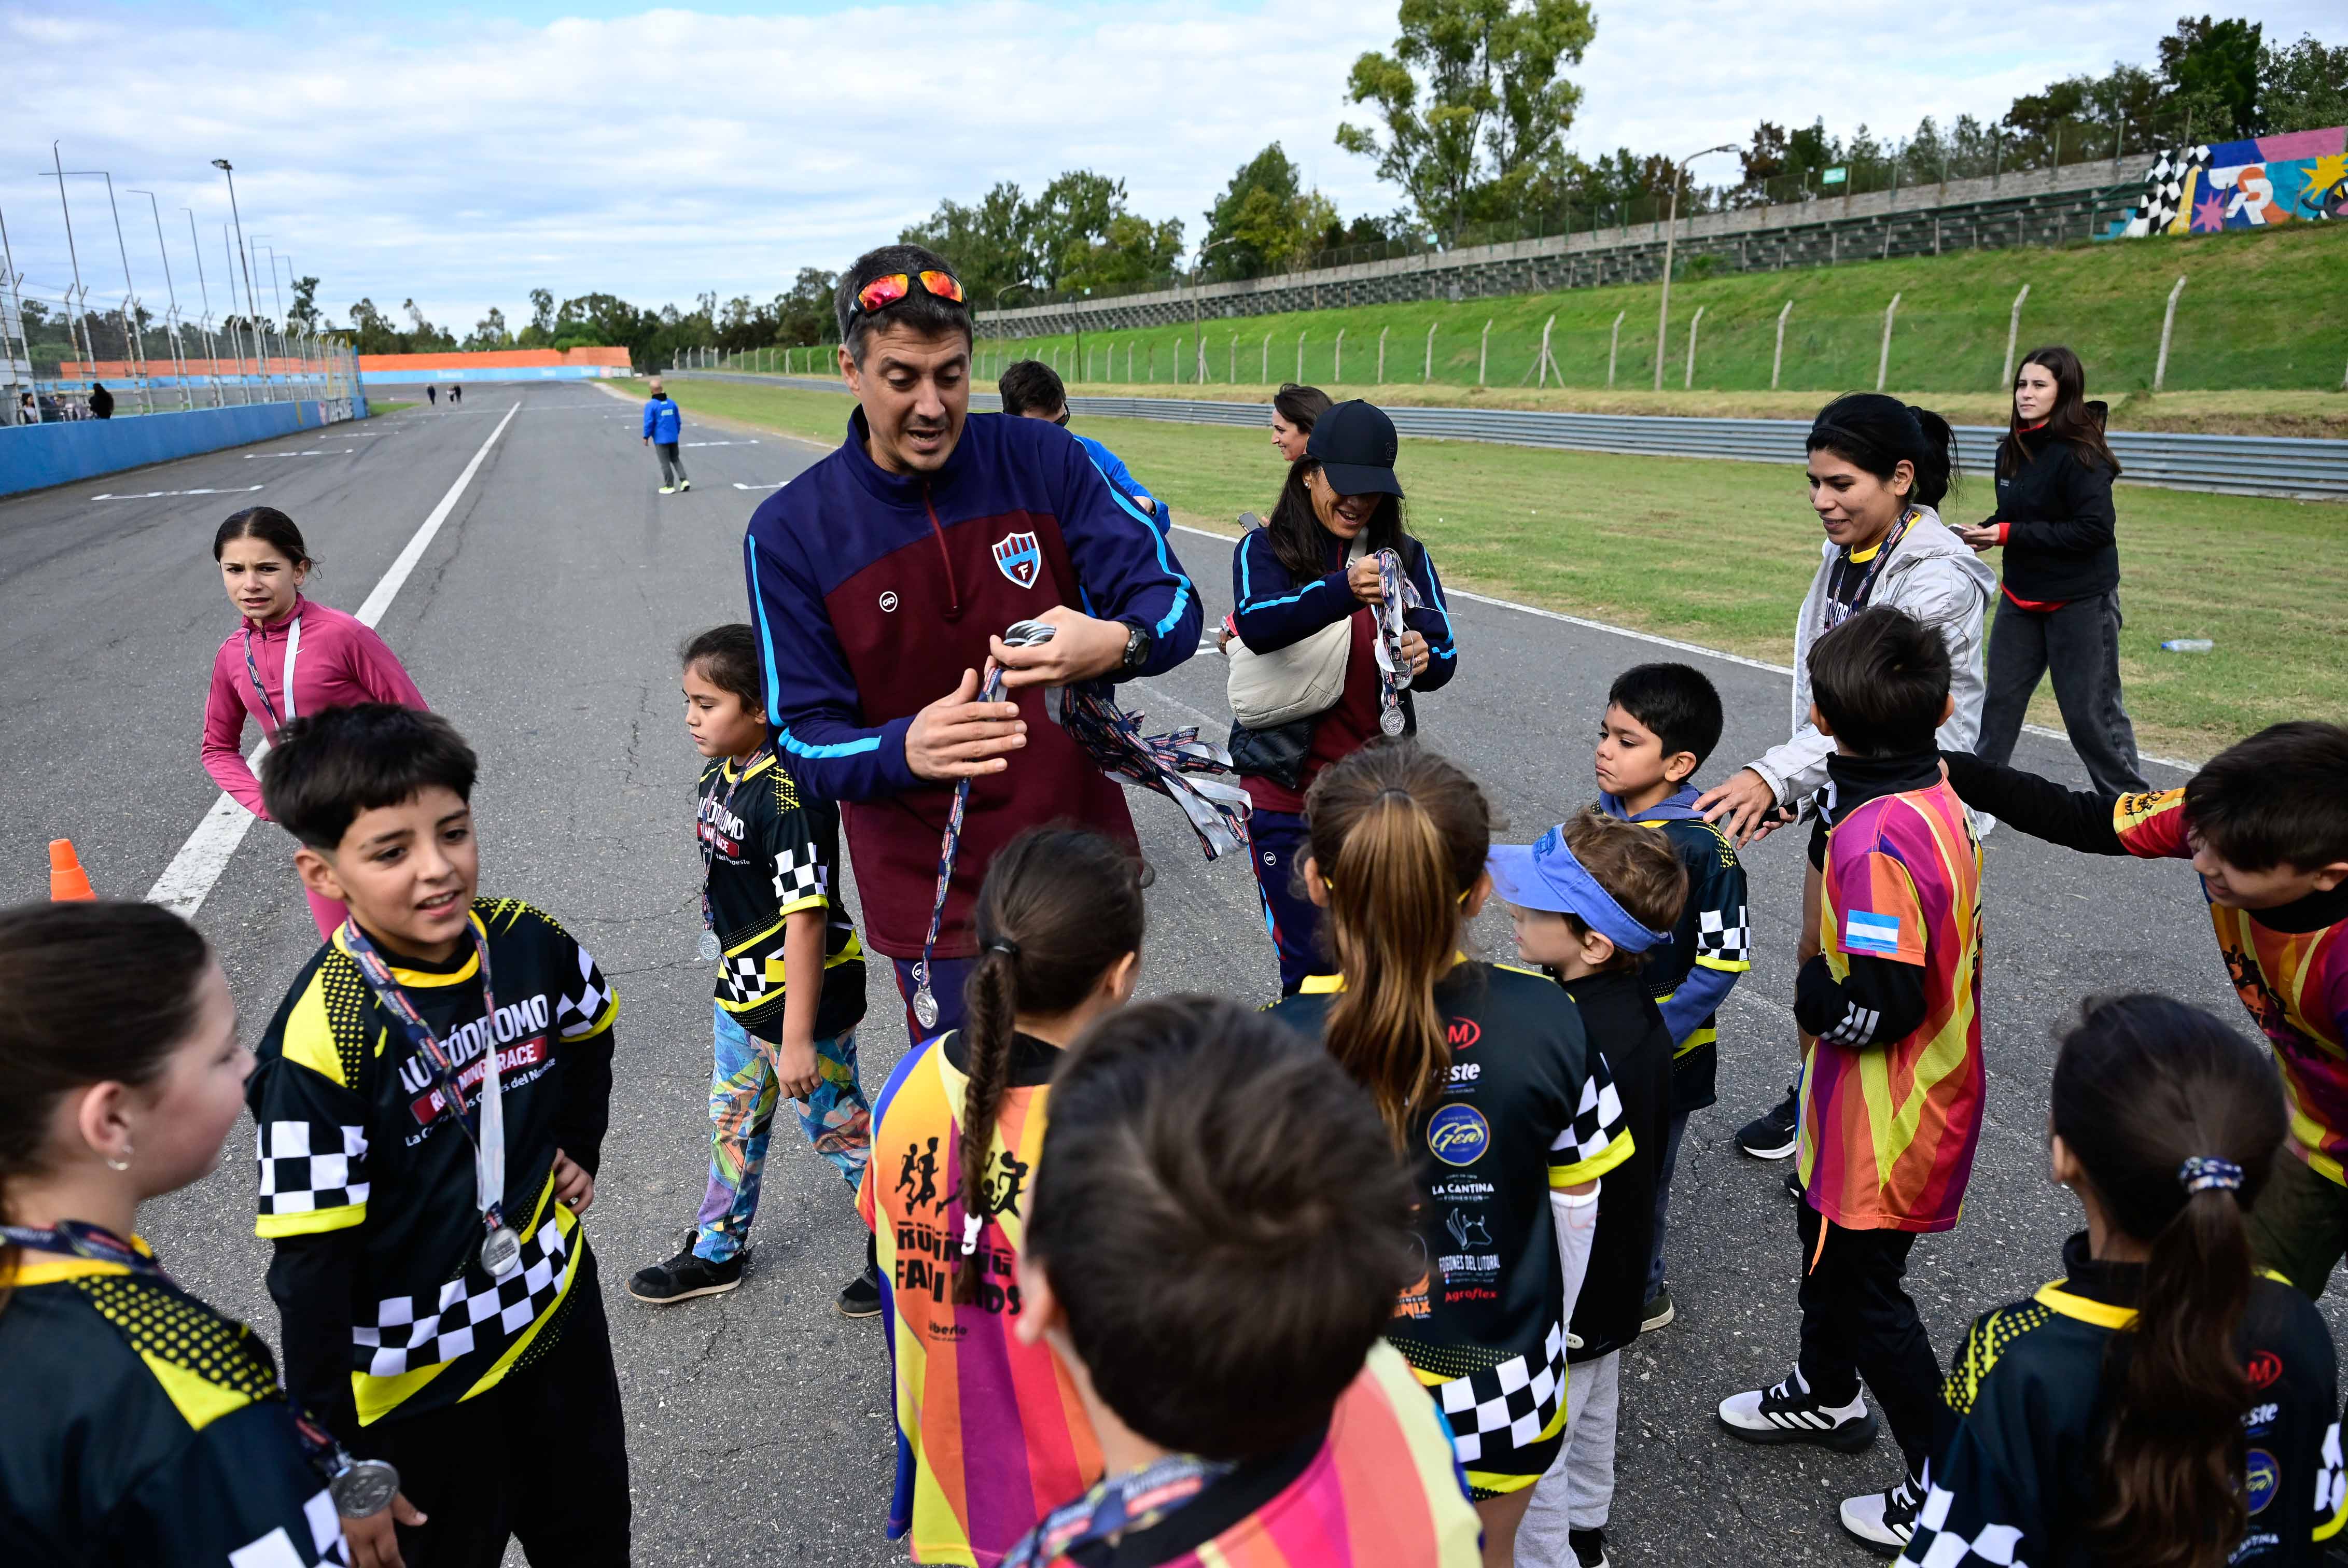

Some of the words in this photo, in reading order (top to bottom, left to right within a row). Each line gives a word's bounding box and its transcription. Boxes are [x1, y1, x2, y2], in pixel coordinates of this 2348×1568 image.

[1225, 815, 1241, 840] AUTODROMO
[497, 1043, 538, 1073] RACE
[511, 1073, 529, 1088] del
[1432, 1185, 1445, 1195] LA
[1447, 1183, 1494, 1194] CANTINA
